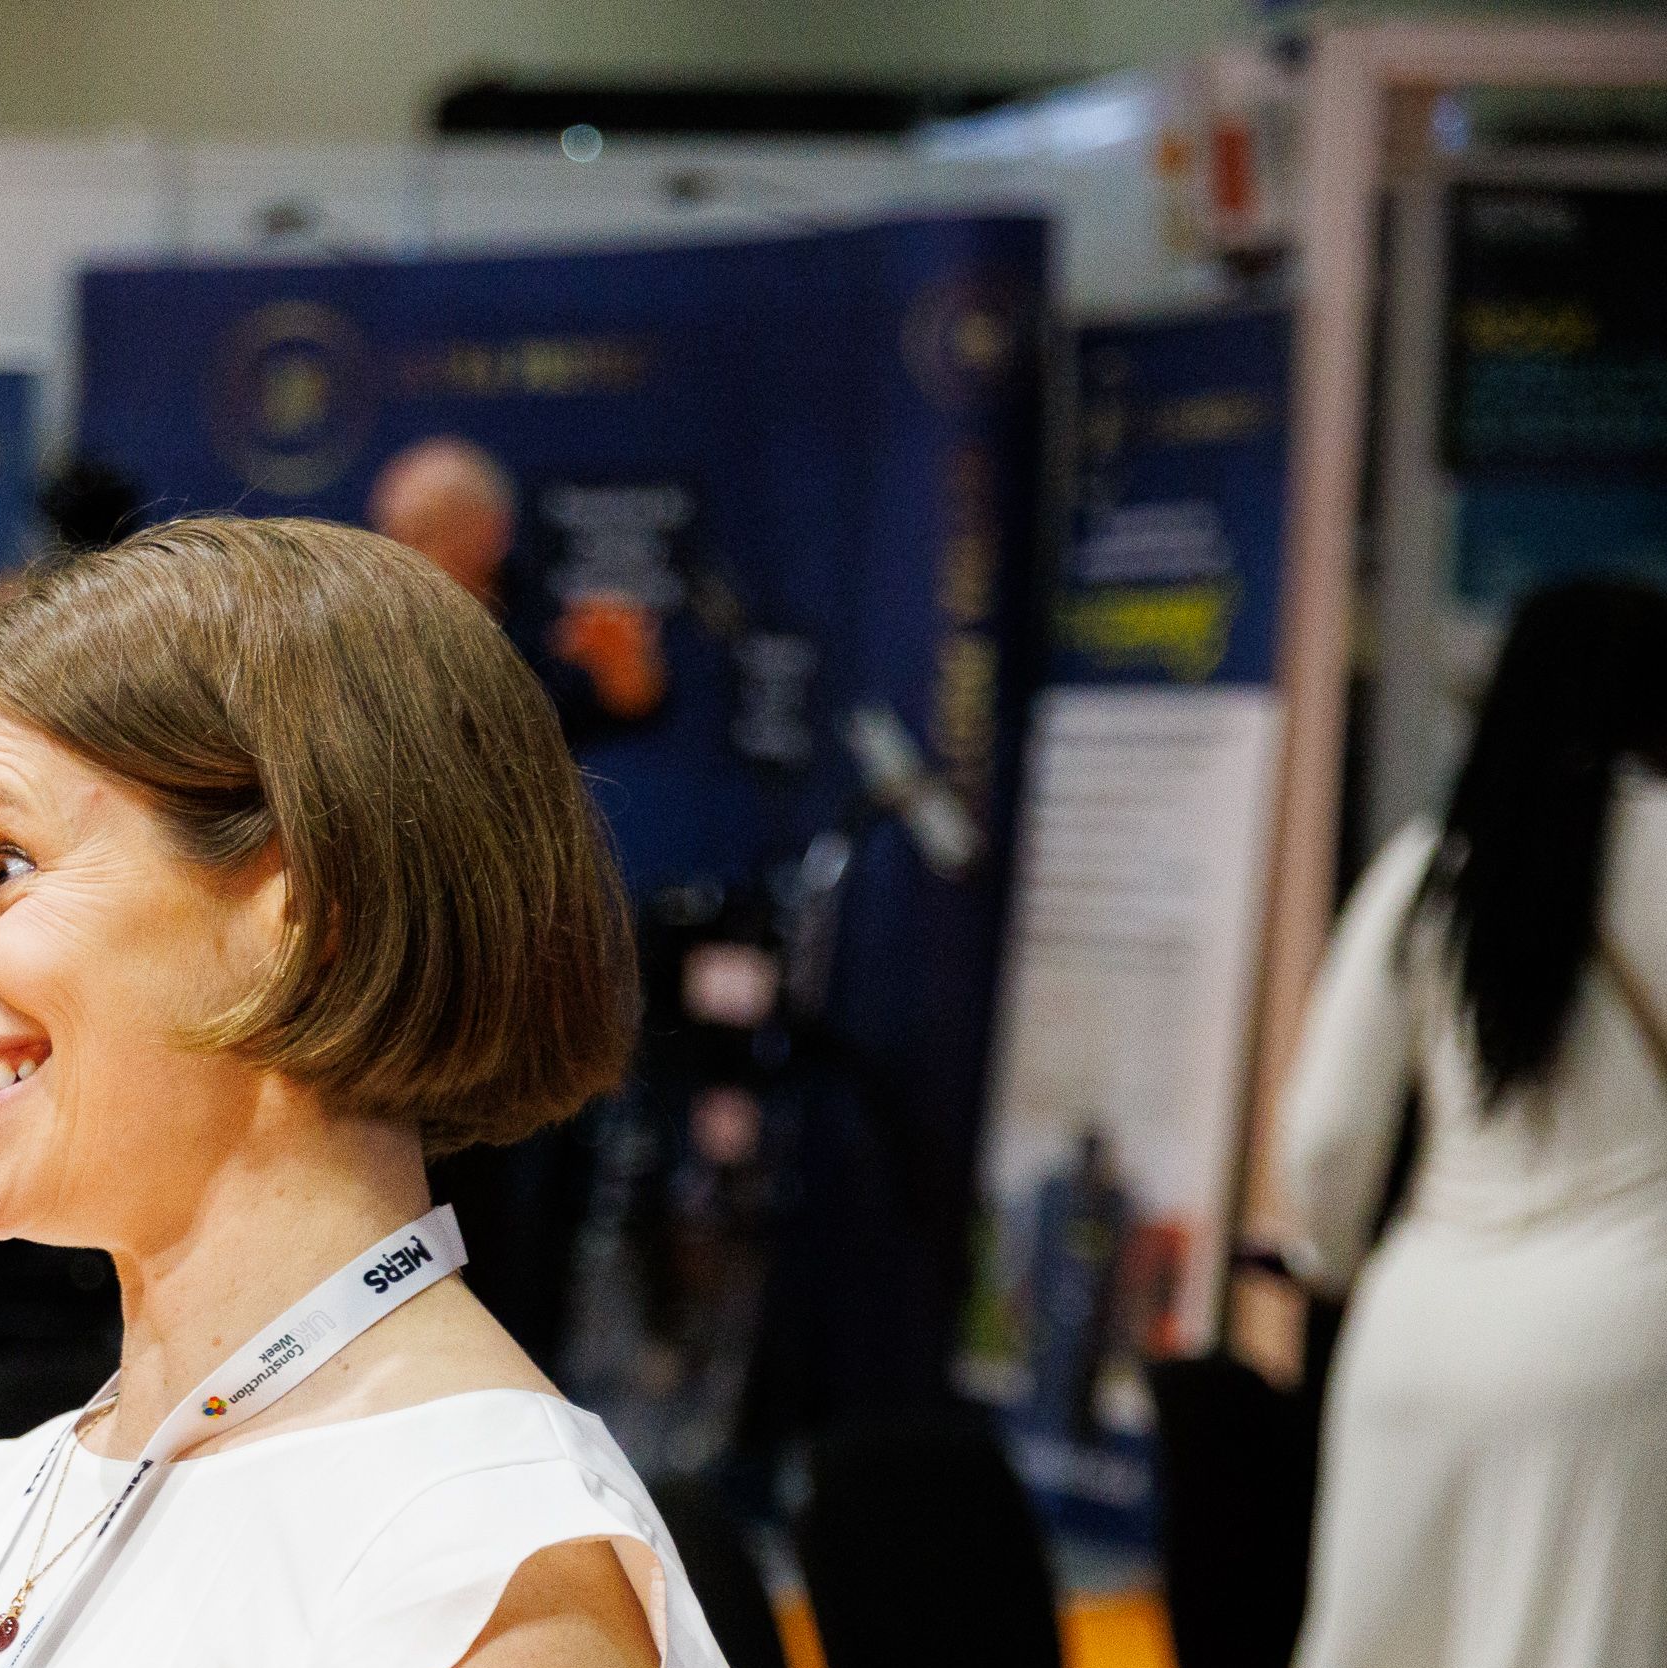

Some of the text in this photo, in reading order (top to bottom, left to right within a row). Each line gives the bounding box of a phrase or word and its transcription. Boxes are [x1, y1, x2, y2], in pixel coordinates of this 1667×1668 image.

[363, 1234, 434, 1294] MERS
[228, 1344, 306, 1406] Construction
[258, 1333, 297, 1363] Week
